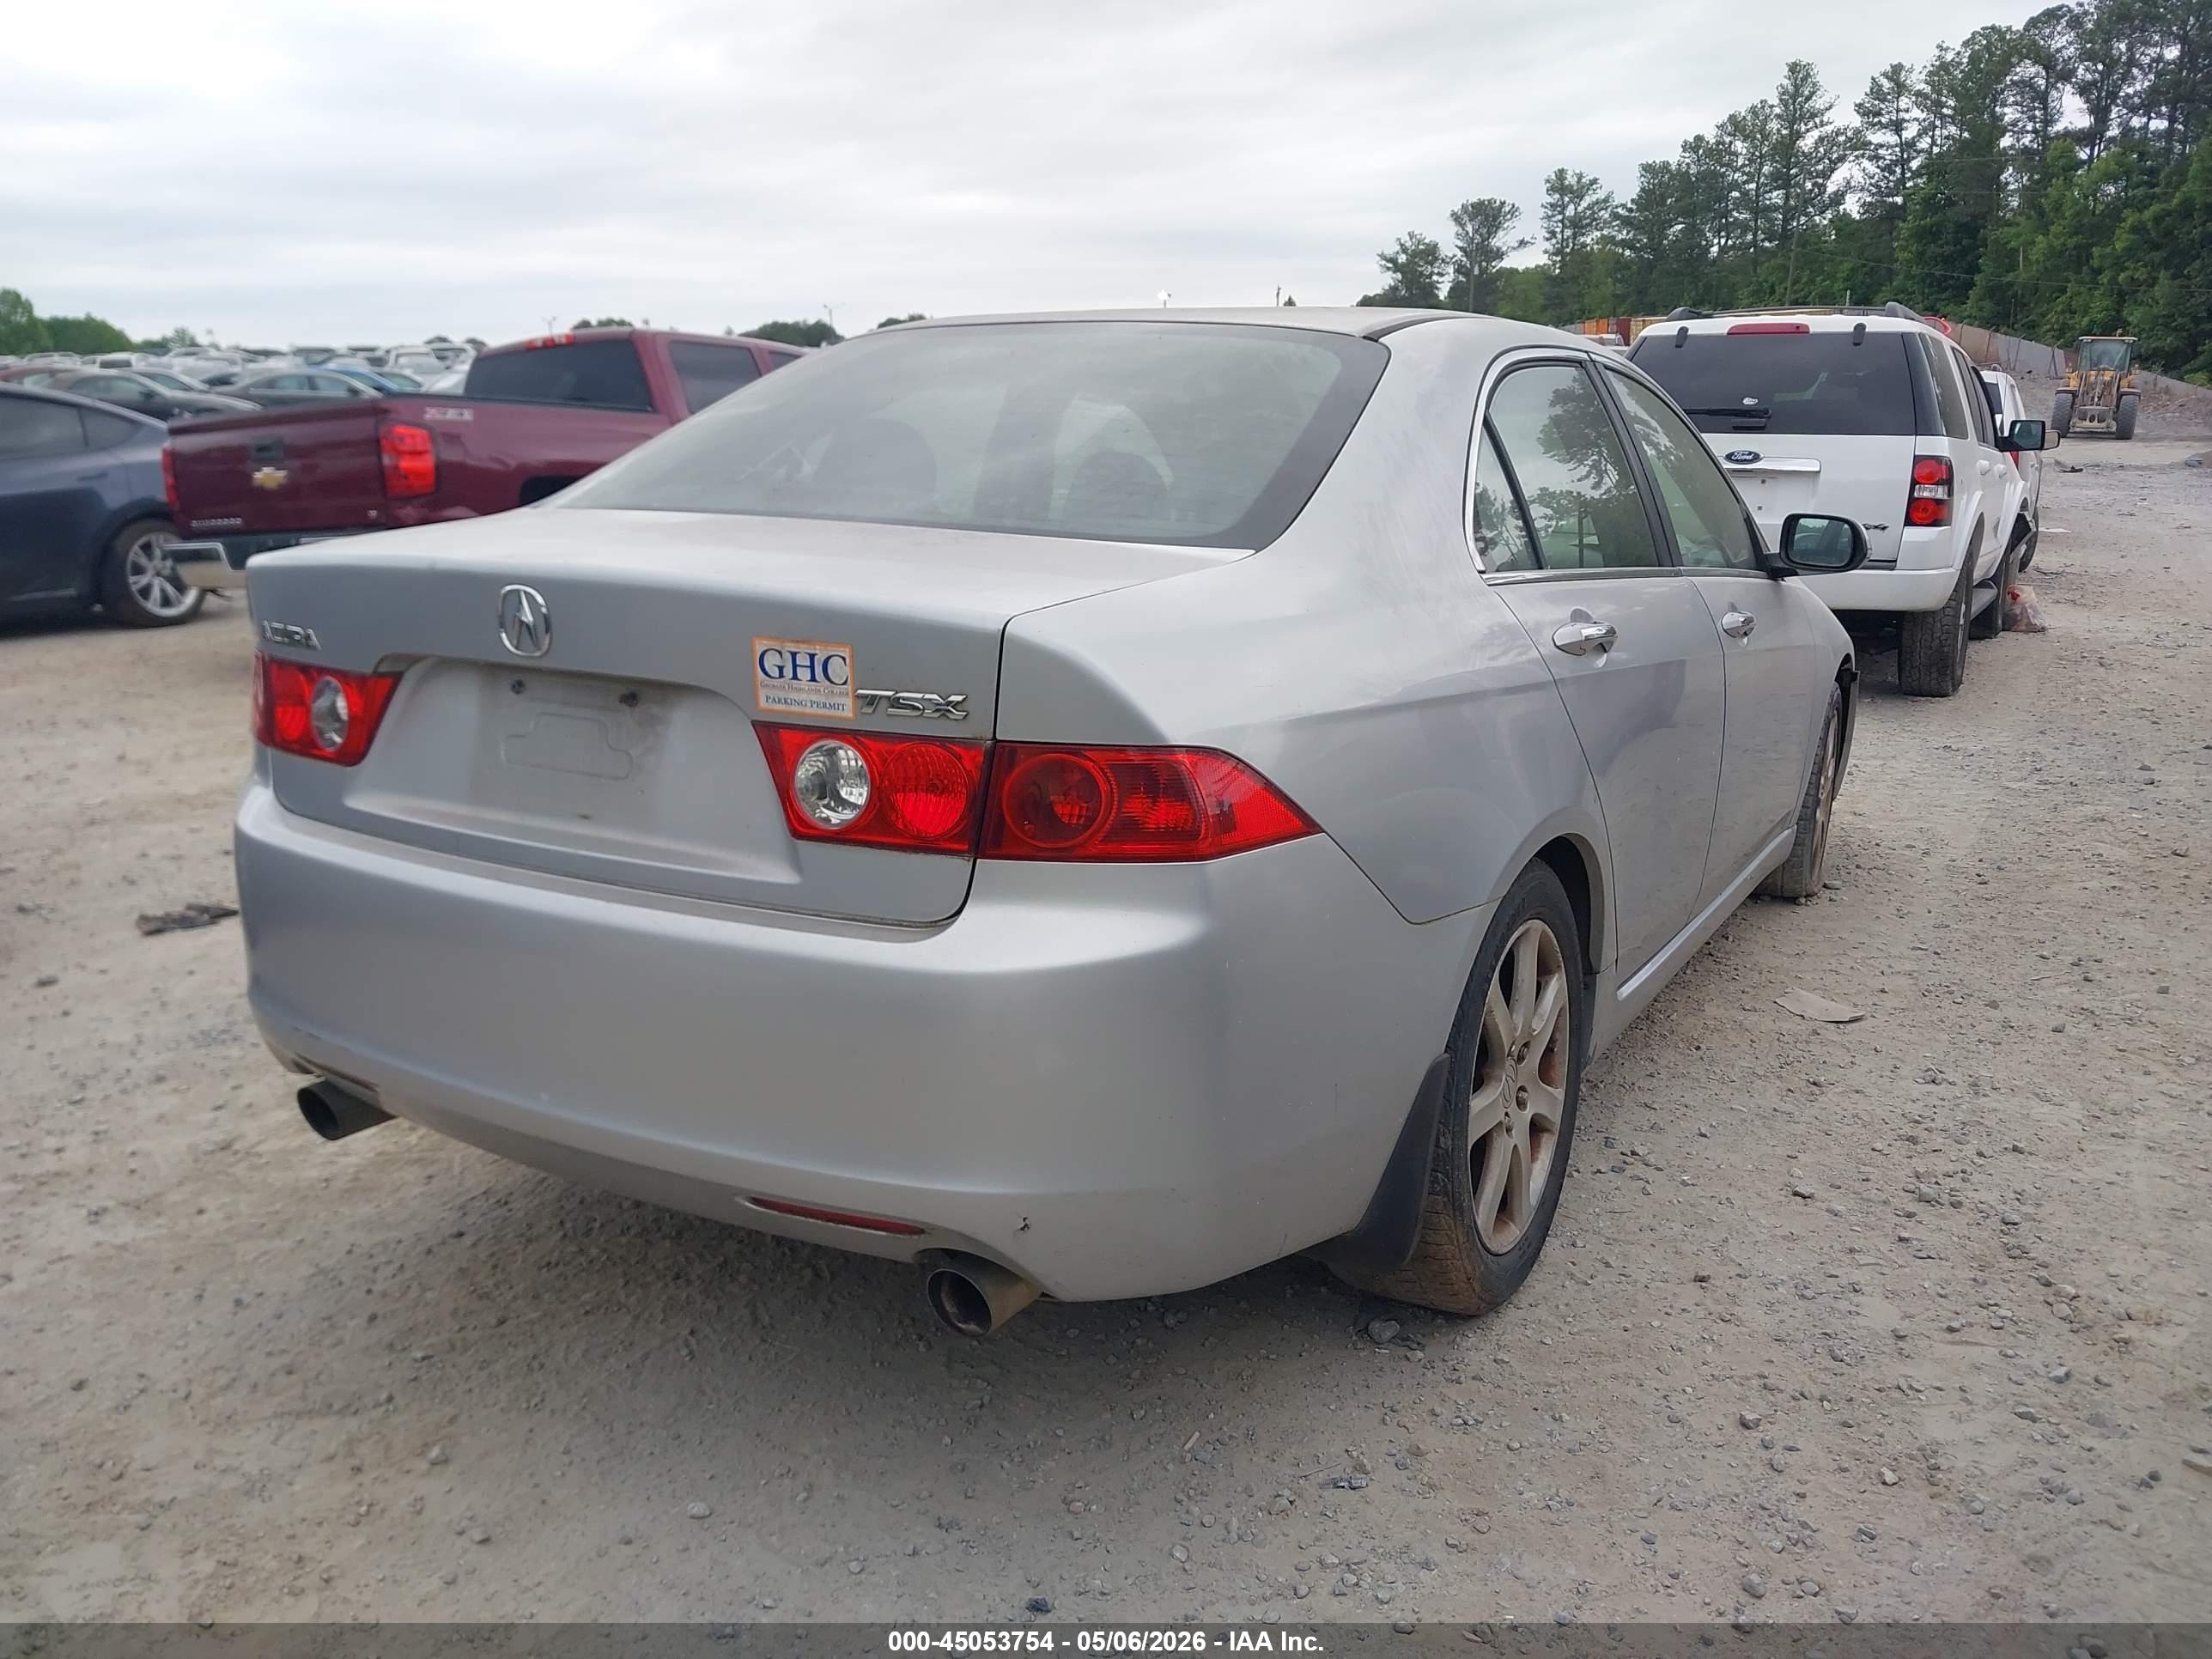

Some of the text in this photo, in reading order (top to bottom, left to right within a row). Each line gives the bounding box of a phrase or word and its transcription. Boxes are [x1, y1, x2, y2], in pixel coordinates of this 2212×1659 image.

[758, 647, 849, 686] GHC
[765, 694, 847, 712] PARKING PERMIT
[854, 690, 969, 720] TSX
